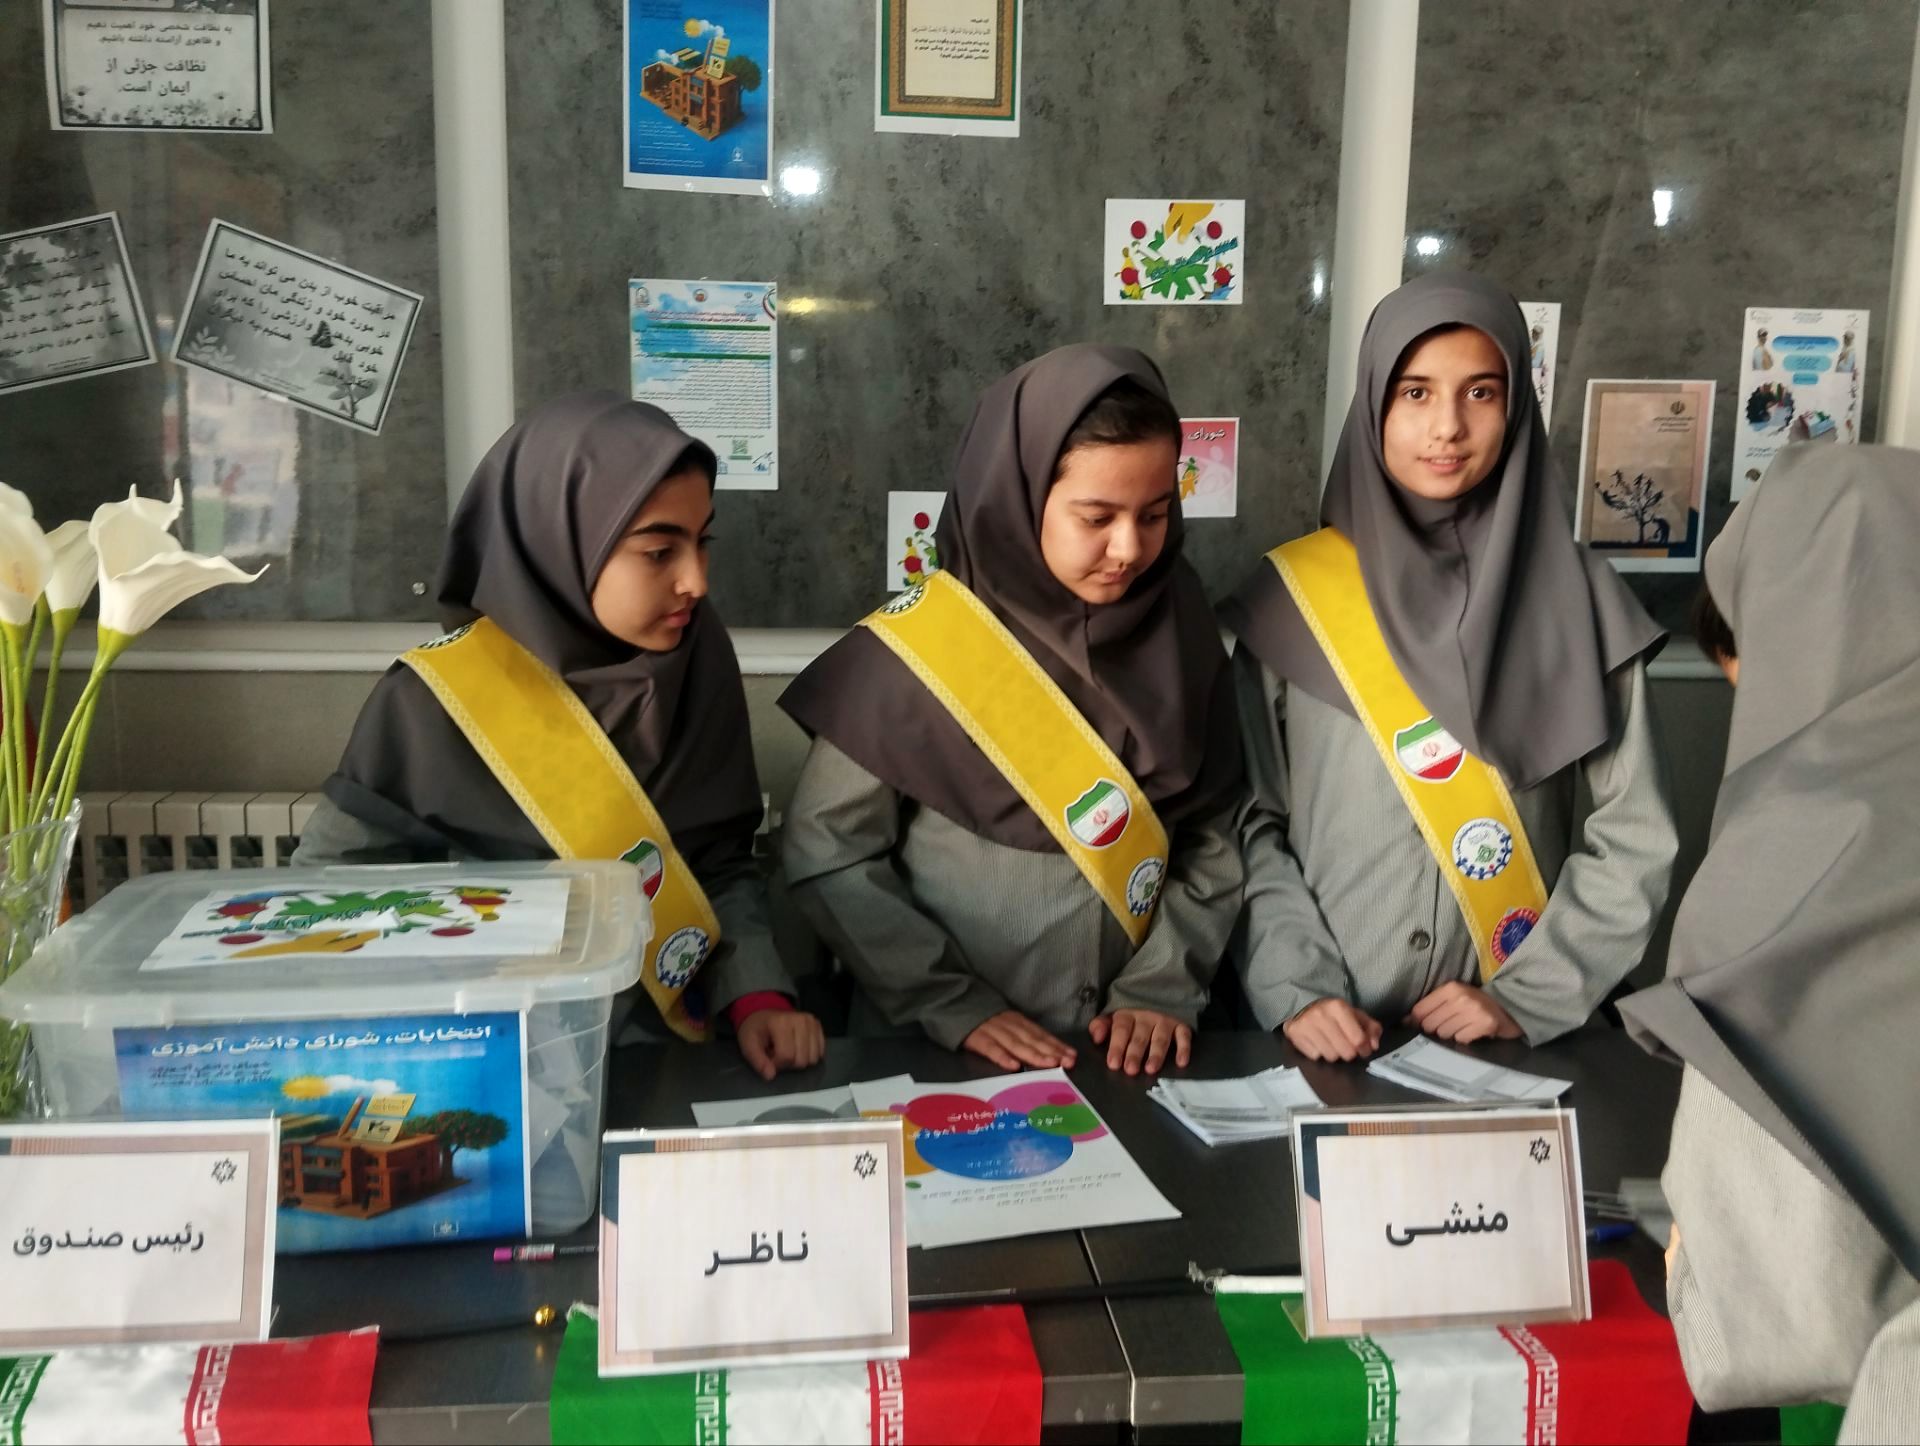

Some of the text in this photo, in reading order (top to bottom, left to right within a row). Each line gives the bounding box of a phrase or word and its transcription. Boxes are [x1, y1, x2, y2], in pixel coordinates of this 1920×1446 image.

[105, 57, 206, 75] نظافت جزئی از
[158, 80, 190, 96] ایمان
[225, 248, 235, 259] ما
[239, 255, 250, 267] به
[298, 279, 317, 292] بدن
[321, 286, 331, 296] از
[281, 292, 312, 311] زندگی
[334, 295, 358, 306] خوب
[315, 307, 323, 315] و
[326, 309, 345, 321] خود
[362, 303, 395, 320] مراقبت
[350, 318, 374, 332] مورد
[356, 345, 383, 355] خوبی
[358, 361, 378, 373] خود
[1187, 426, 1226, 442] شورای
[151, 1037, 226, 1058] آموزی
[229, 1035, 300, 1055] دانش
[304, 1031, 380, 1050] شورای
[1385, 1201, 1509, 1248] منشی
[13, 1221, 204, 1256] رئیس صندوق
[704, 1230, 809, 1276] ناظر
